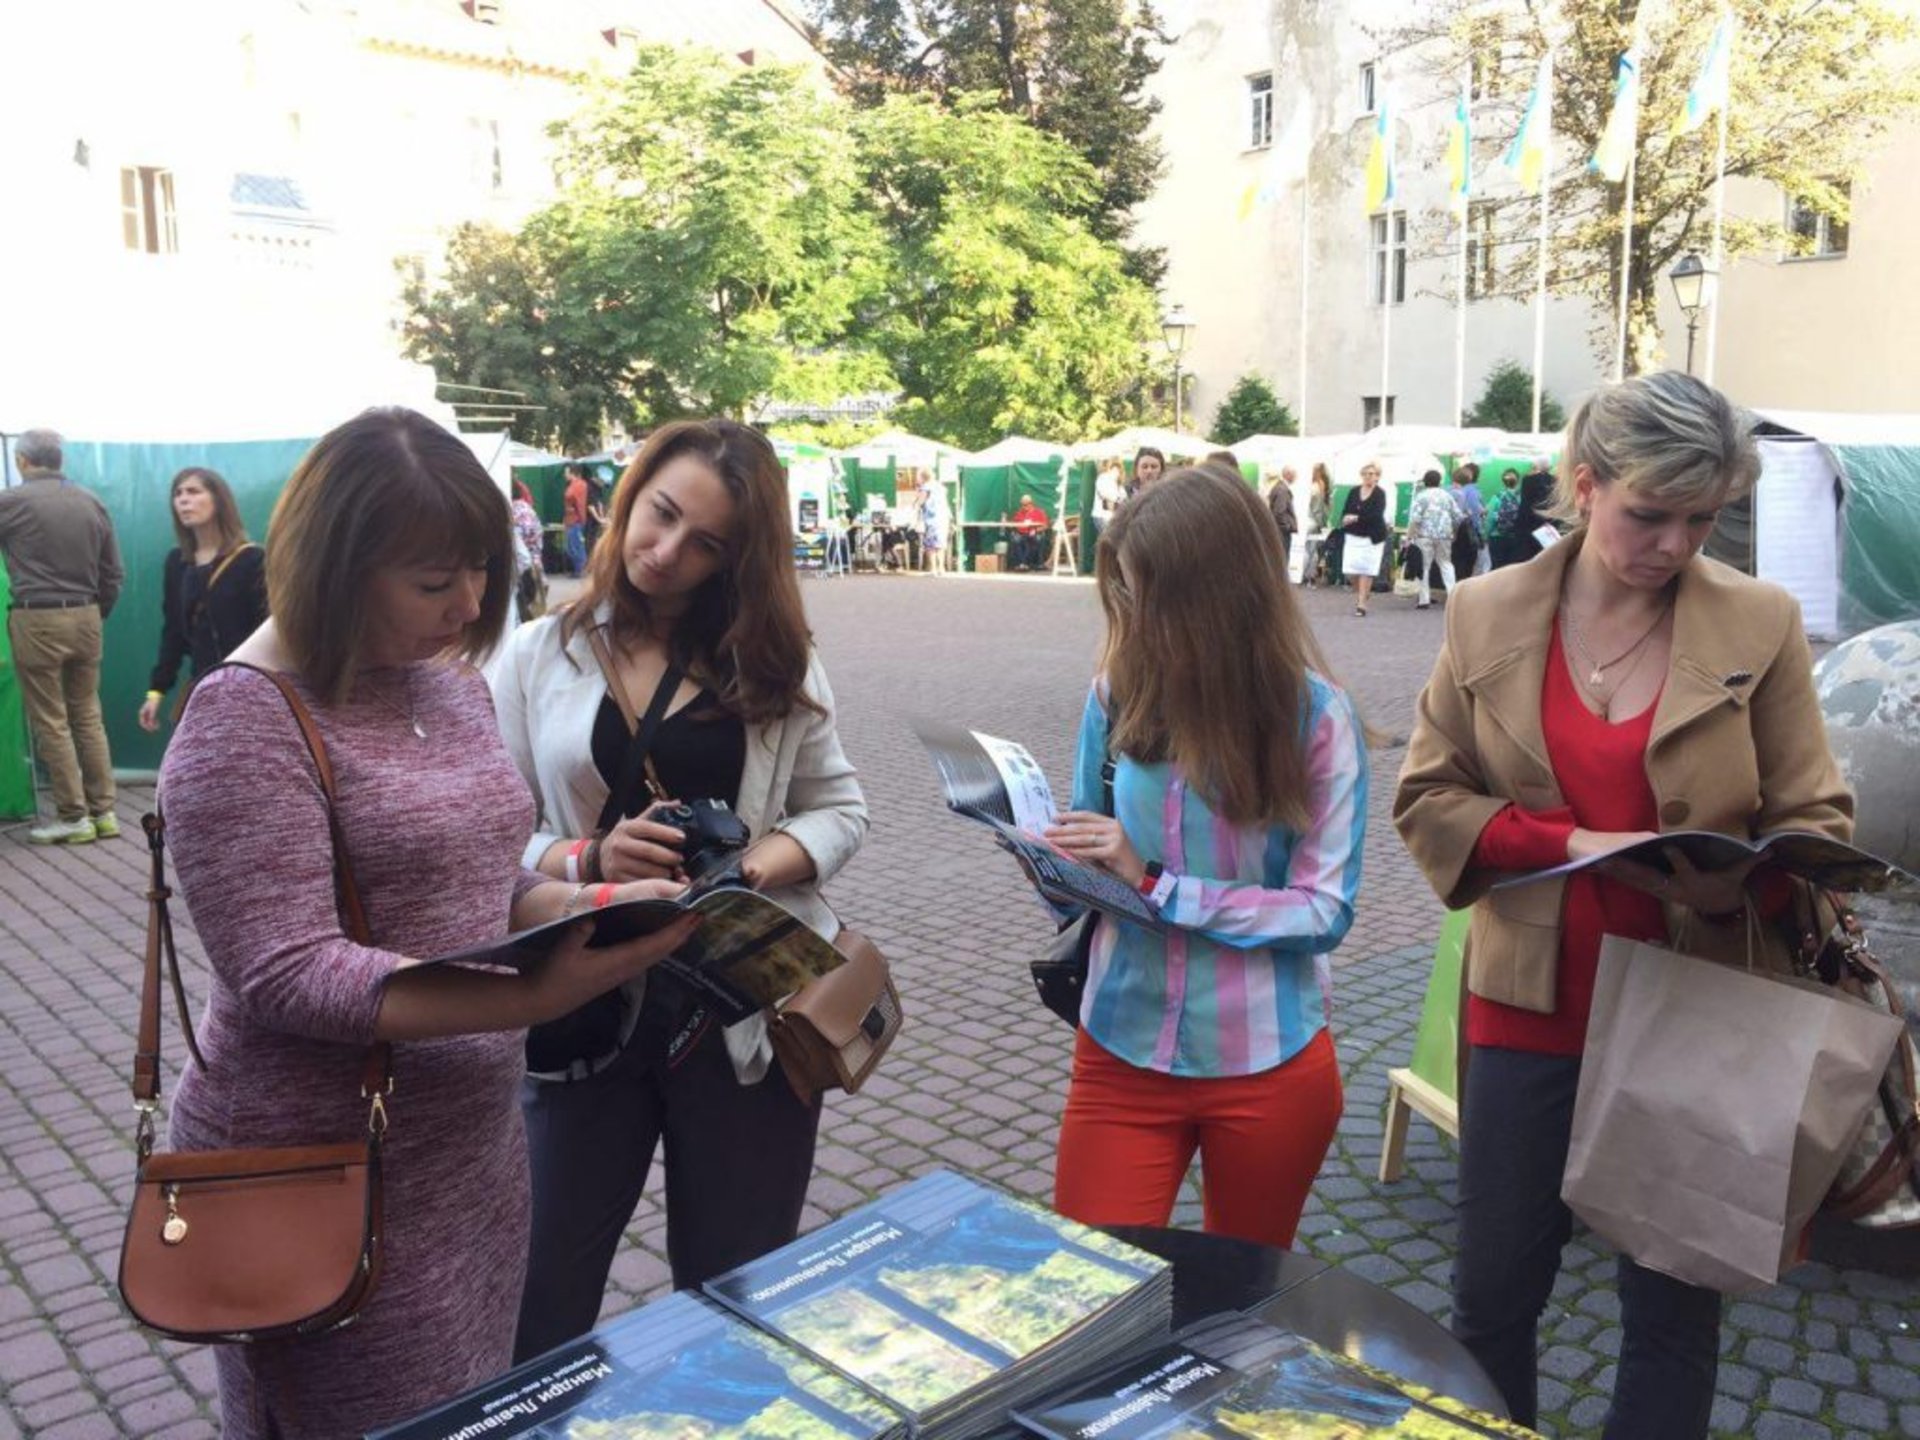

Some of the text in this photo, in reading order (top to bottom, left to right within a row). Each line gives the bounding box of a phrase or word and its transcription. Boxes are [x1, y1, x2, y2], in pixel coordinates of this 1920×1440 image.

[842, 1227, 904, 1258] Мандри
[537, 1362, 614, 1403] Мандри
[541, 1375, 554, 1386] та
[1160, 1362, 1222, 1394] Мандри
